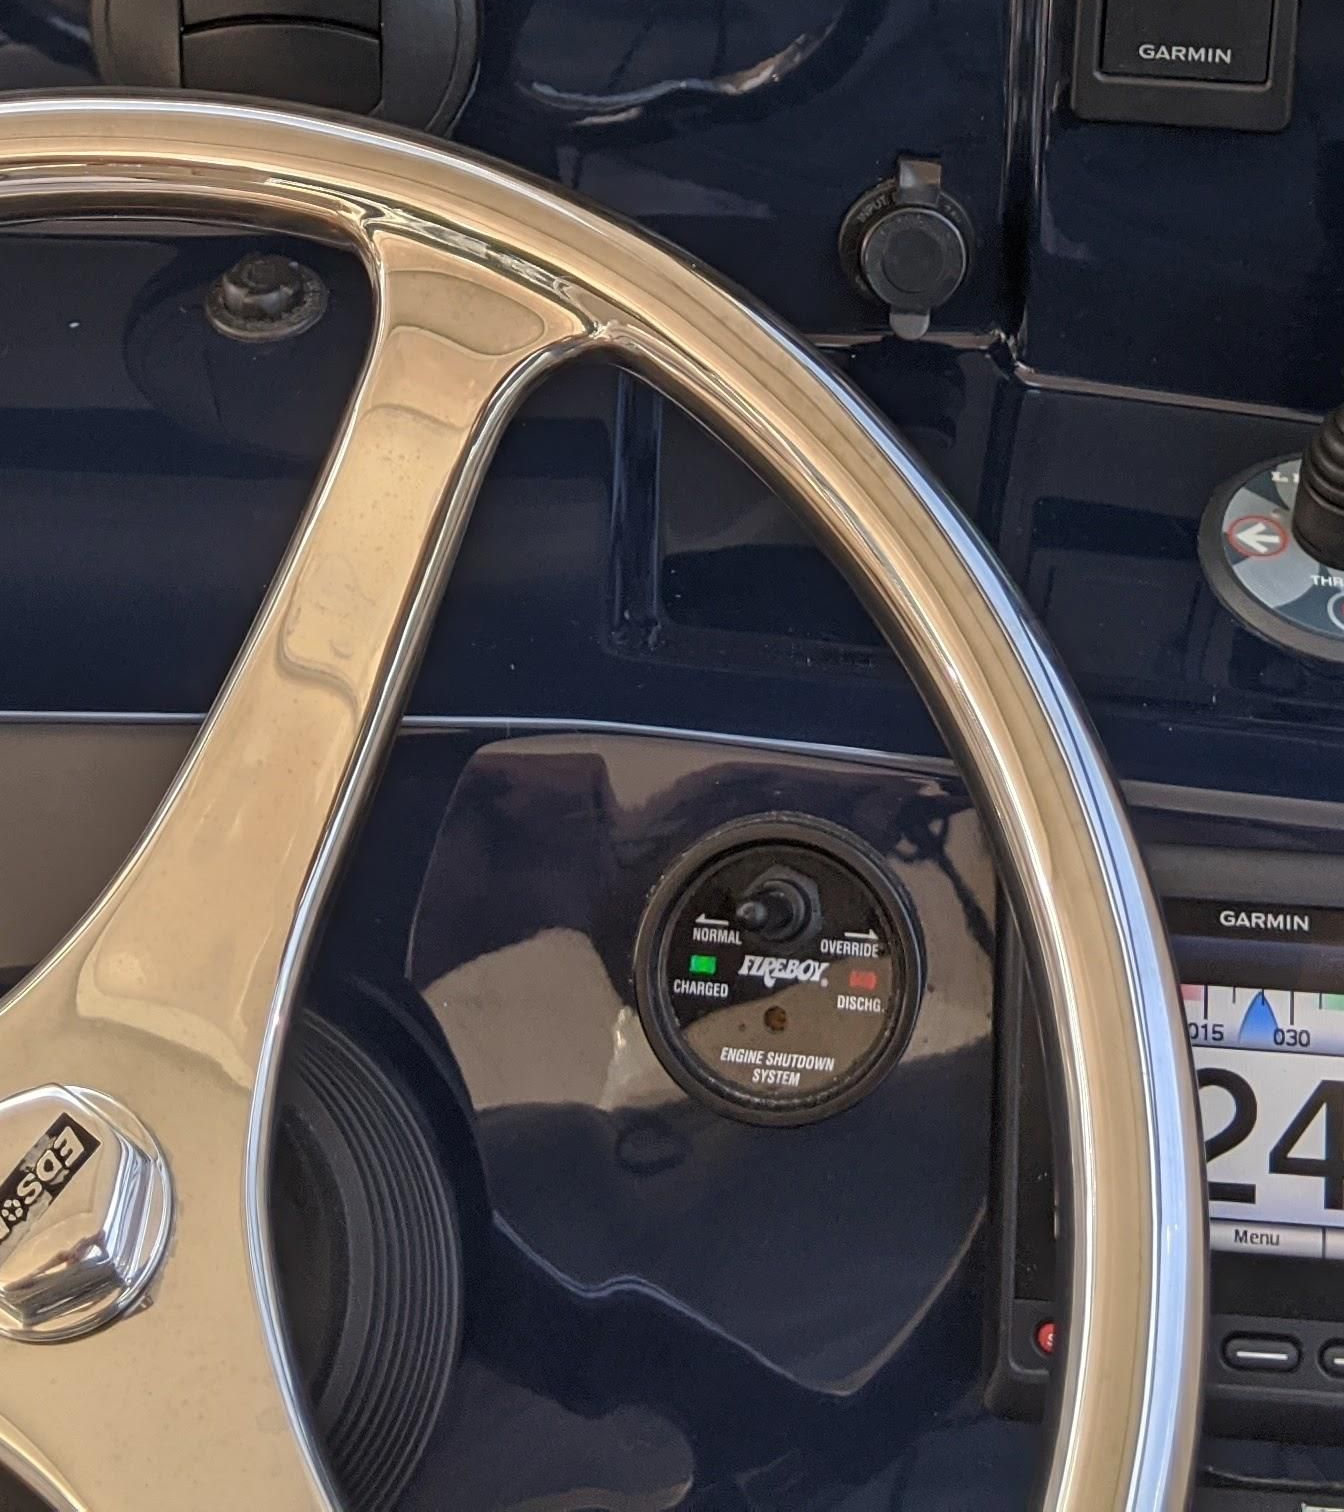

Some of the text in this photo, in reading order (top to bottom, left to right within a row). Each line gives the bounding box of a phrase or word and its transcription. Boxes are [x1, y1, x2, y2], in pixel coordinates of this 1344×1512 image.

[1138, 44, 1233, 65] GARMIN
[1219, 910, 1311, 932] GARMIN
[693, 927, 743, 946] NORMAL
[820, 939, 879, 958] OVERRIDE
[738, 954, 830, 988] FIREBOY
[673, 979, 729, 998] CHARGED
[1188, 1022, 1225, 1044] 015
[1273, 1028, 1312, 1049] 030
[720, 1046, 835, 1072] ENGINE SHUTDOWN
[752, 1068, 801, 1087] SYSTEM
[1233, 1228, 1281, 1248] Menu
